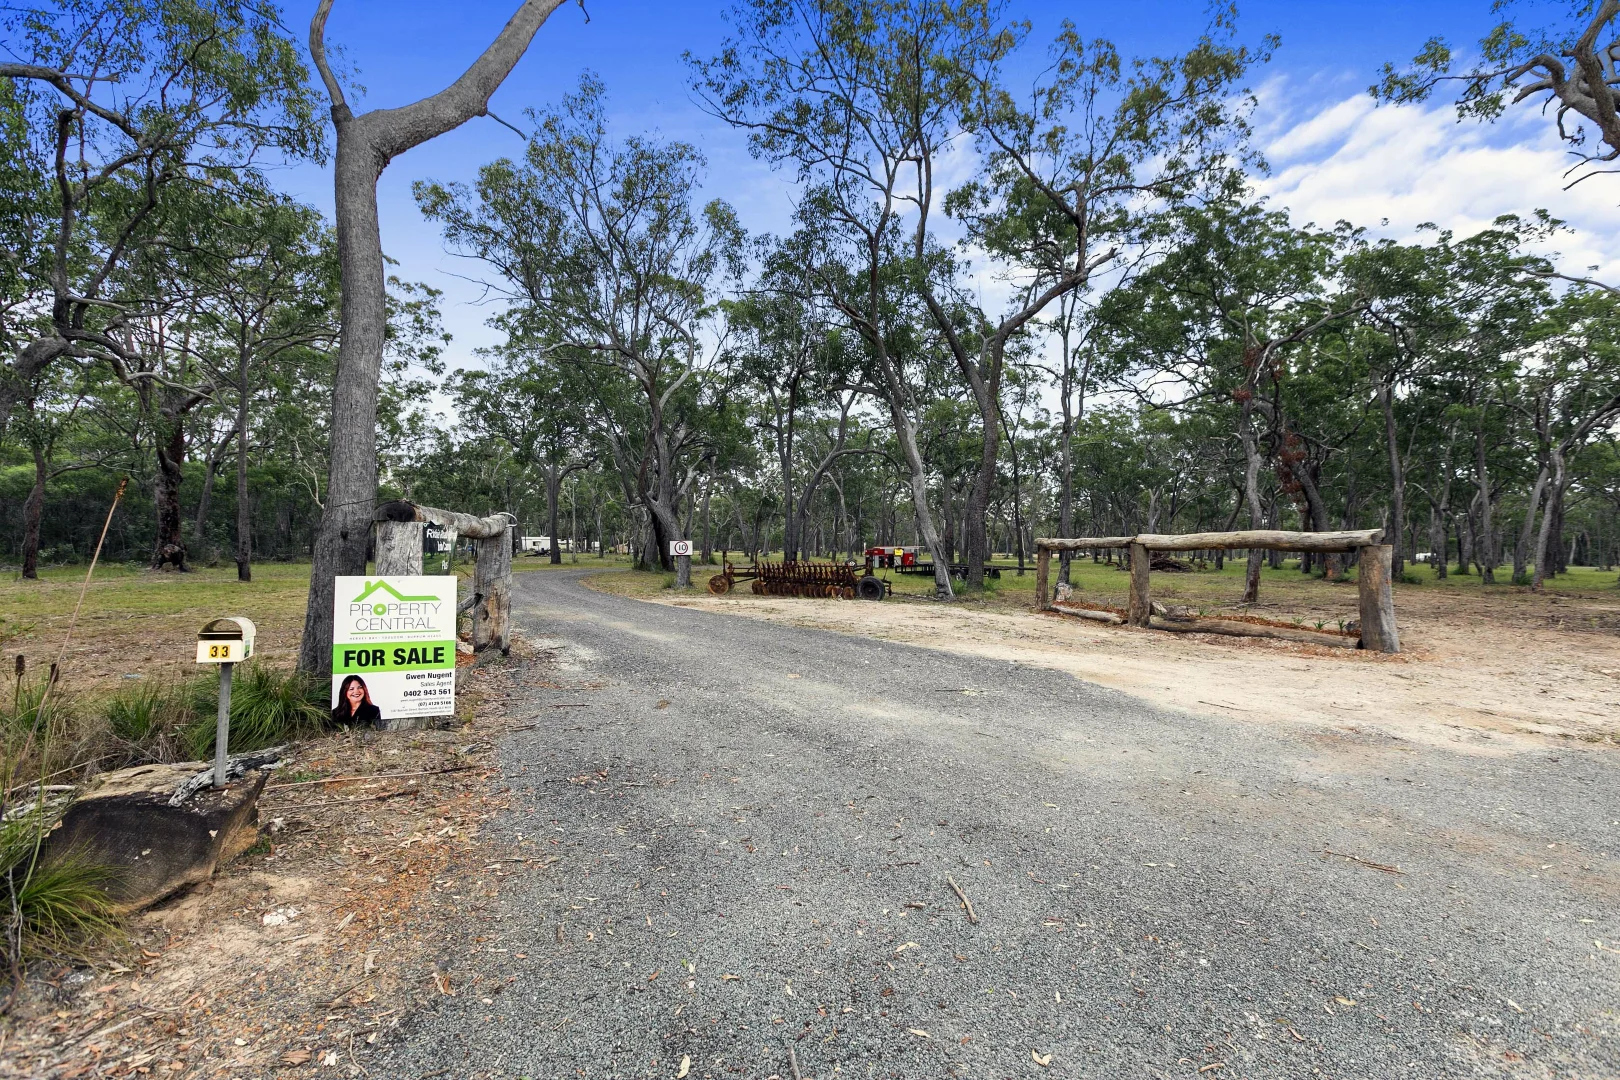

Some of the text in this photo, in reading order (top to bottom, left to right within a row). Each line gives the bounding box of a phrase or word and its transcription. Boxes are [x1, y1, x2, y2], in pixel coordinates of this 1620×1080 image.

[349, 602, 442, 616] PROPERTY
[355, 616, 436, 631] CENTRAL
[211, 645, 229, 658] 33
[344, 646, 445, 667] FOR SALE
